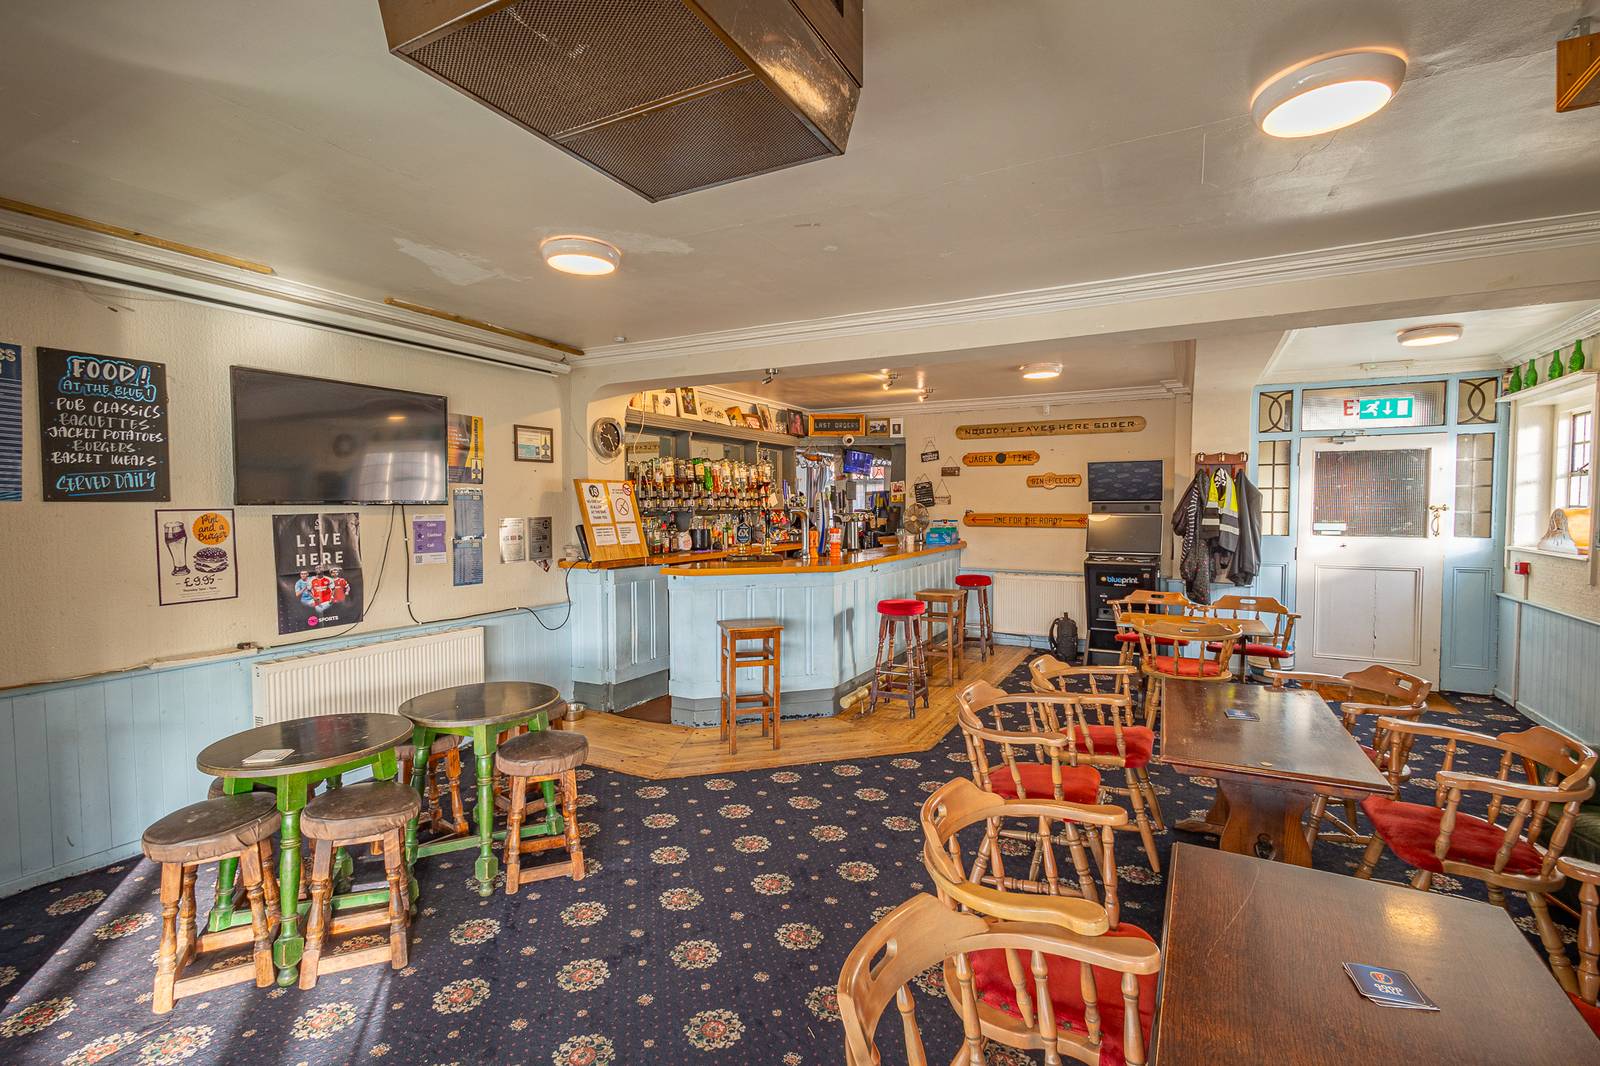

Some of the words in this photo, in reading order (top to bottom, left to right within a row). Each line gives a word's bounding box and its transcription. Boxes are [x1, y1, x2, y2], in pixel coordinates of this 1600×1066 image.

[72, 359, 148, 383] FOOD!
[63, 380, 81, 391] AT
[87, 383, 110, 393] THE
[57, 398, 86, 411] PUB
[94, 401, 161, 419] CLASSICS
[59, 413, 150, 430] BAGUETTES
[964, 426, 1007, 435] NOBODY
[1010, 424, 1055, 433] LEAVES
[1058, 423, 1089, 431] HERE
[1093, 421, 1136, 429] SOBER
[48, 426, 100, 439] JACKET
[103, 429, 165, 442] POTATOES
[72, 440, 137, 453] BURGERS
[51, 452, 103, 465] BASKET
[111, 454, 158, 466] MEALS
[1013, 454, 1033, 462] TIME
[56, 475, 111, 492] SERVED
[114, 472, 156, 490] DAILY
[199, 522, 216, 532] and
[993, 516, 1008, 524] ONE
[1009, 516, 1021, 524] FOR
[1025, 516, 1038, 525] THE
[738, 528, 749, 537] 6X
[296, 533, 342, 547] LIVE
[295, 551, 344, 567] HERE
[184, 574, 216, 587] £9.95
[1106, 575, 1138, 584] blueprint
